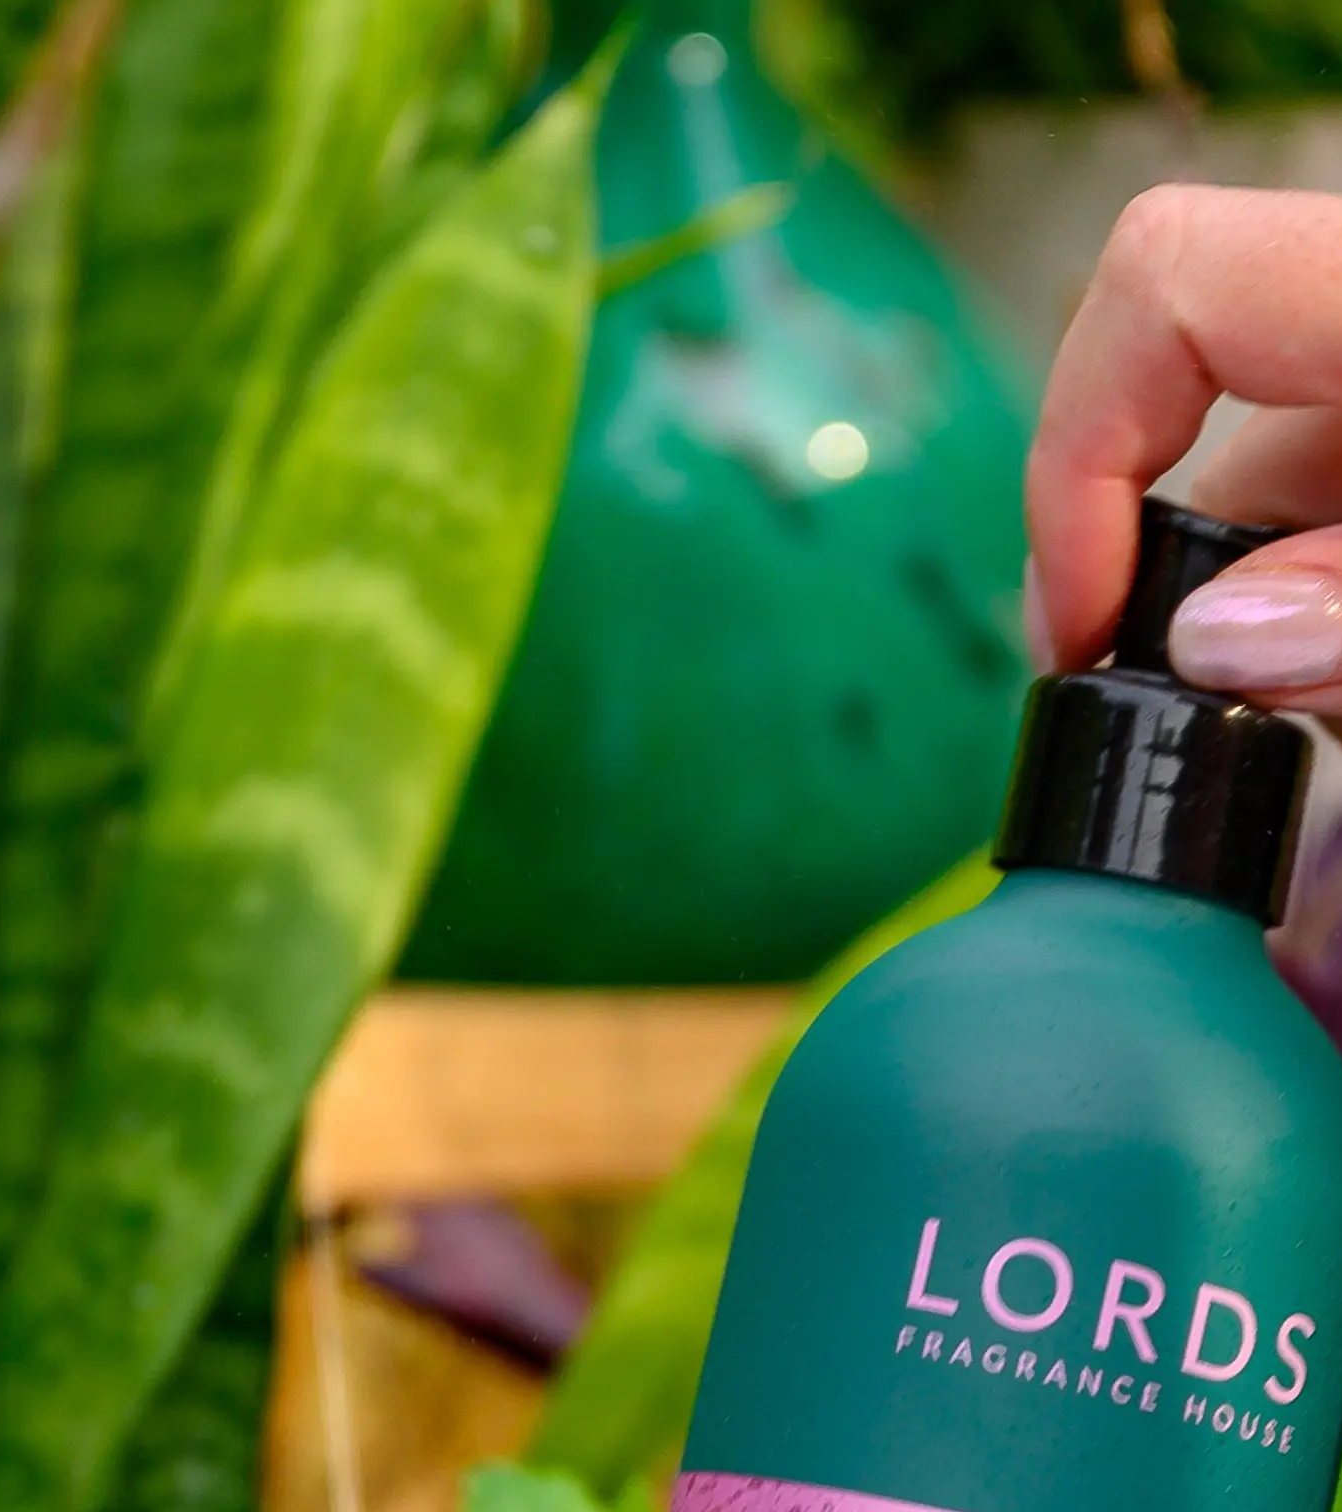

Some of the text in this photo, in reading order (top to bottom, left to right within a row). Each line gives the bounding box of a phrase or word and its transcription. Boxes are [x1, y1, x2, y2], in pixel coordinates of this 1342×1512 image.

[895, 1325, 1295, 1454] FRAGRANCE HOUSE
[906, 1217, 1316, 1405] LORDS
